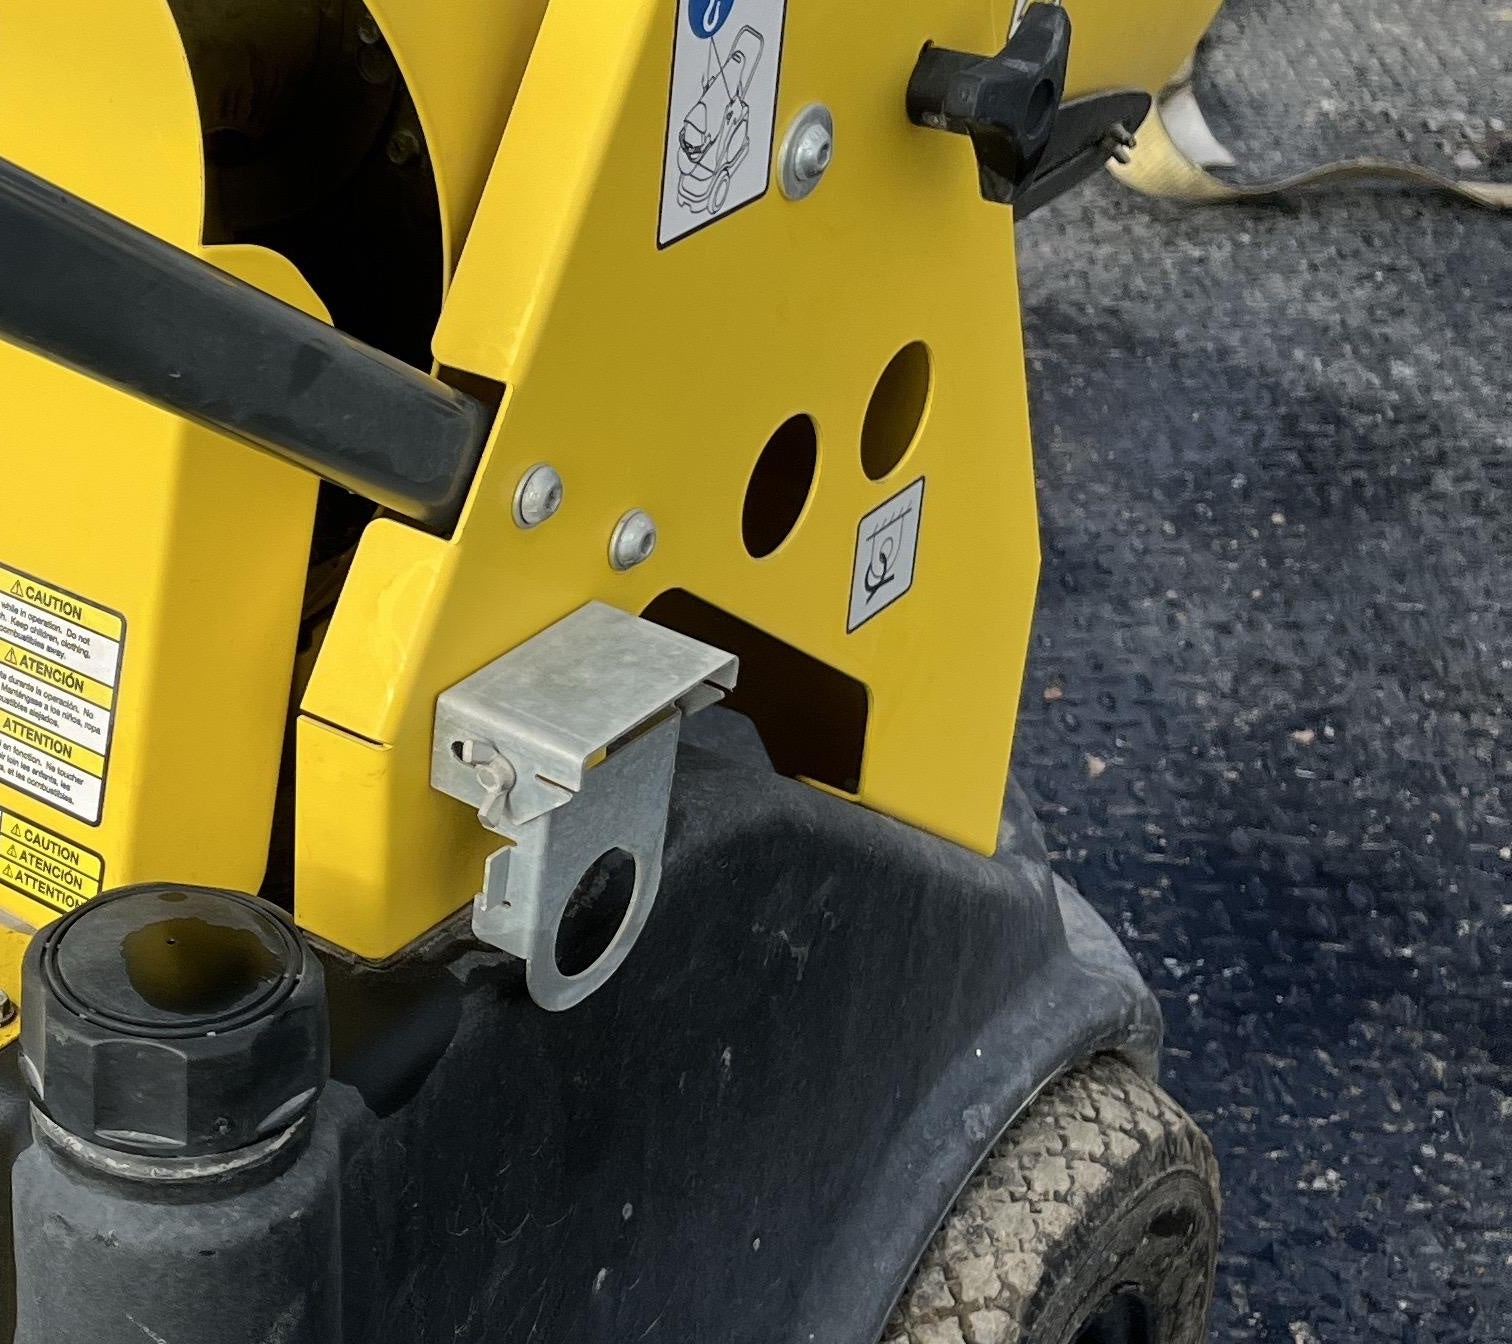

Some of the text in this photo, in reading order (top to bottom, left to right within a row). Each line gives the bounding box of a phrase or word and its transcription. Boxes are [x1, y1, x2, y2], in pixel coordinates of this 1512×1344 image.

[24, 585, 82, 620] CAUTION
[1, 602, 18, 615] while
[19, 608, 26, 618] in
[27, 613, 62, 634] operation.
[66, 627, 76, 639] Do
[78, 634, 90, 645] not
[19, 653, 84, 693] ATENCIÓN
[2, 715, 72, 758] ATTENTION
[23, 827, 79, 865] CAUTION
[19, 848, 82, 890] ATENCIÓN
